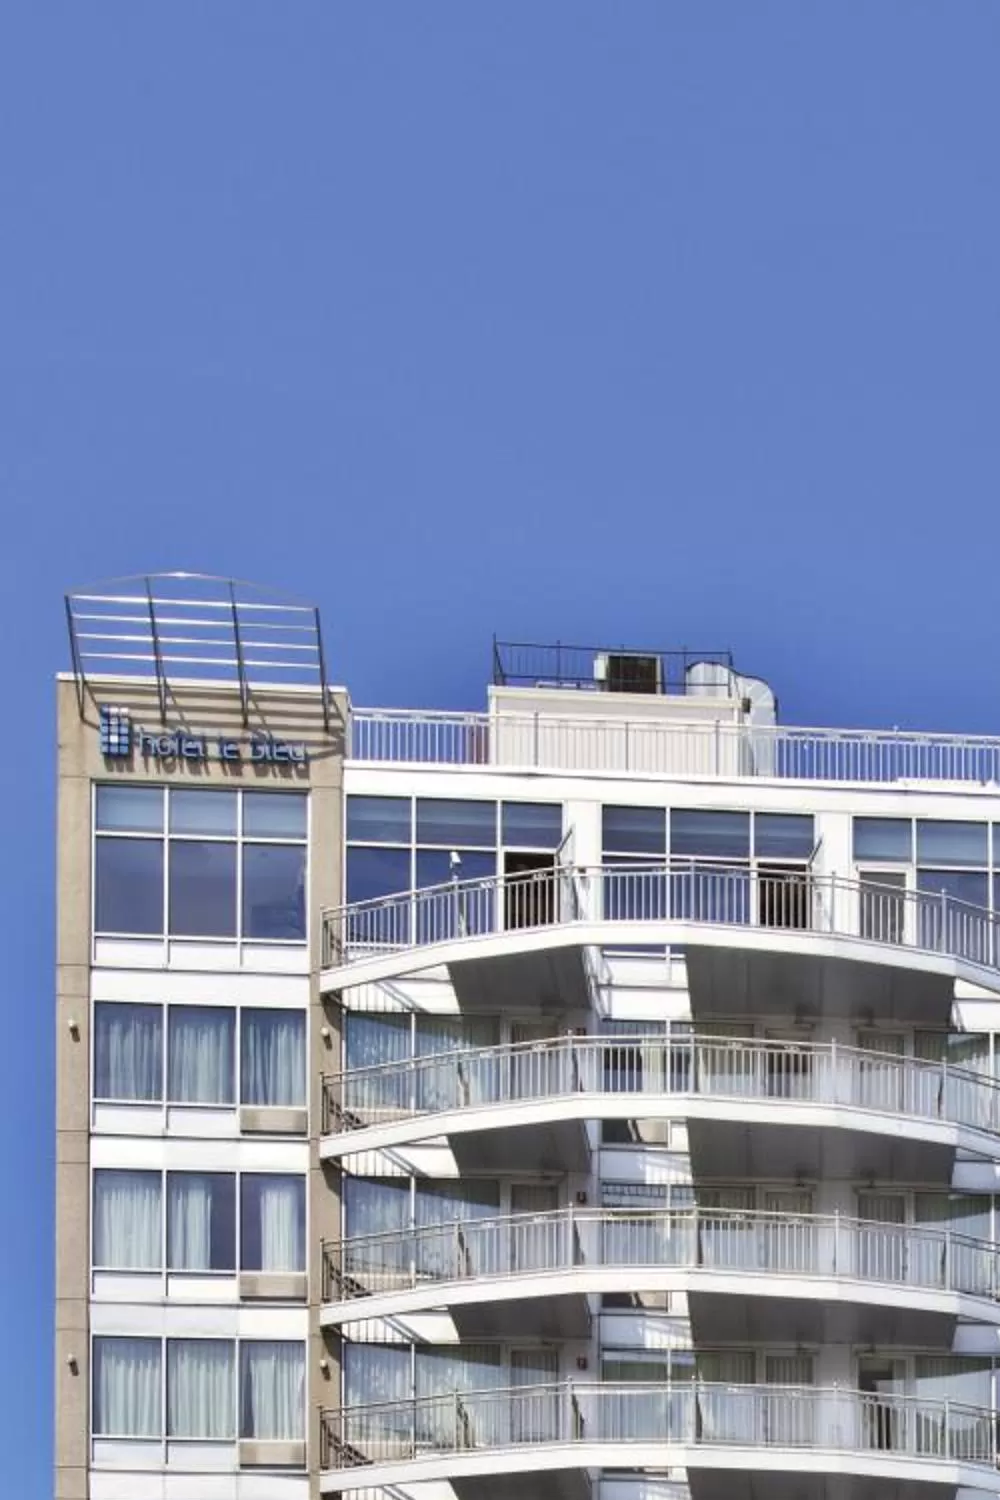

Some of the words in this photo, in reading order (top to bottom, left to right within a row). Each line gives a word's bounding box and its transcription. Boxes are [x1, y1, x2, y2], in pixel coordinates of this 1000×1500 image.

[139, 727, 205, 758] hotel
[215, 731, 239, 760] le
[249, 731, 307, 762] bleu
